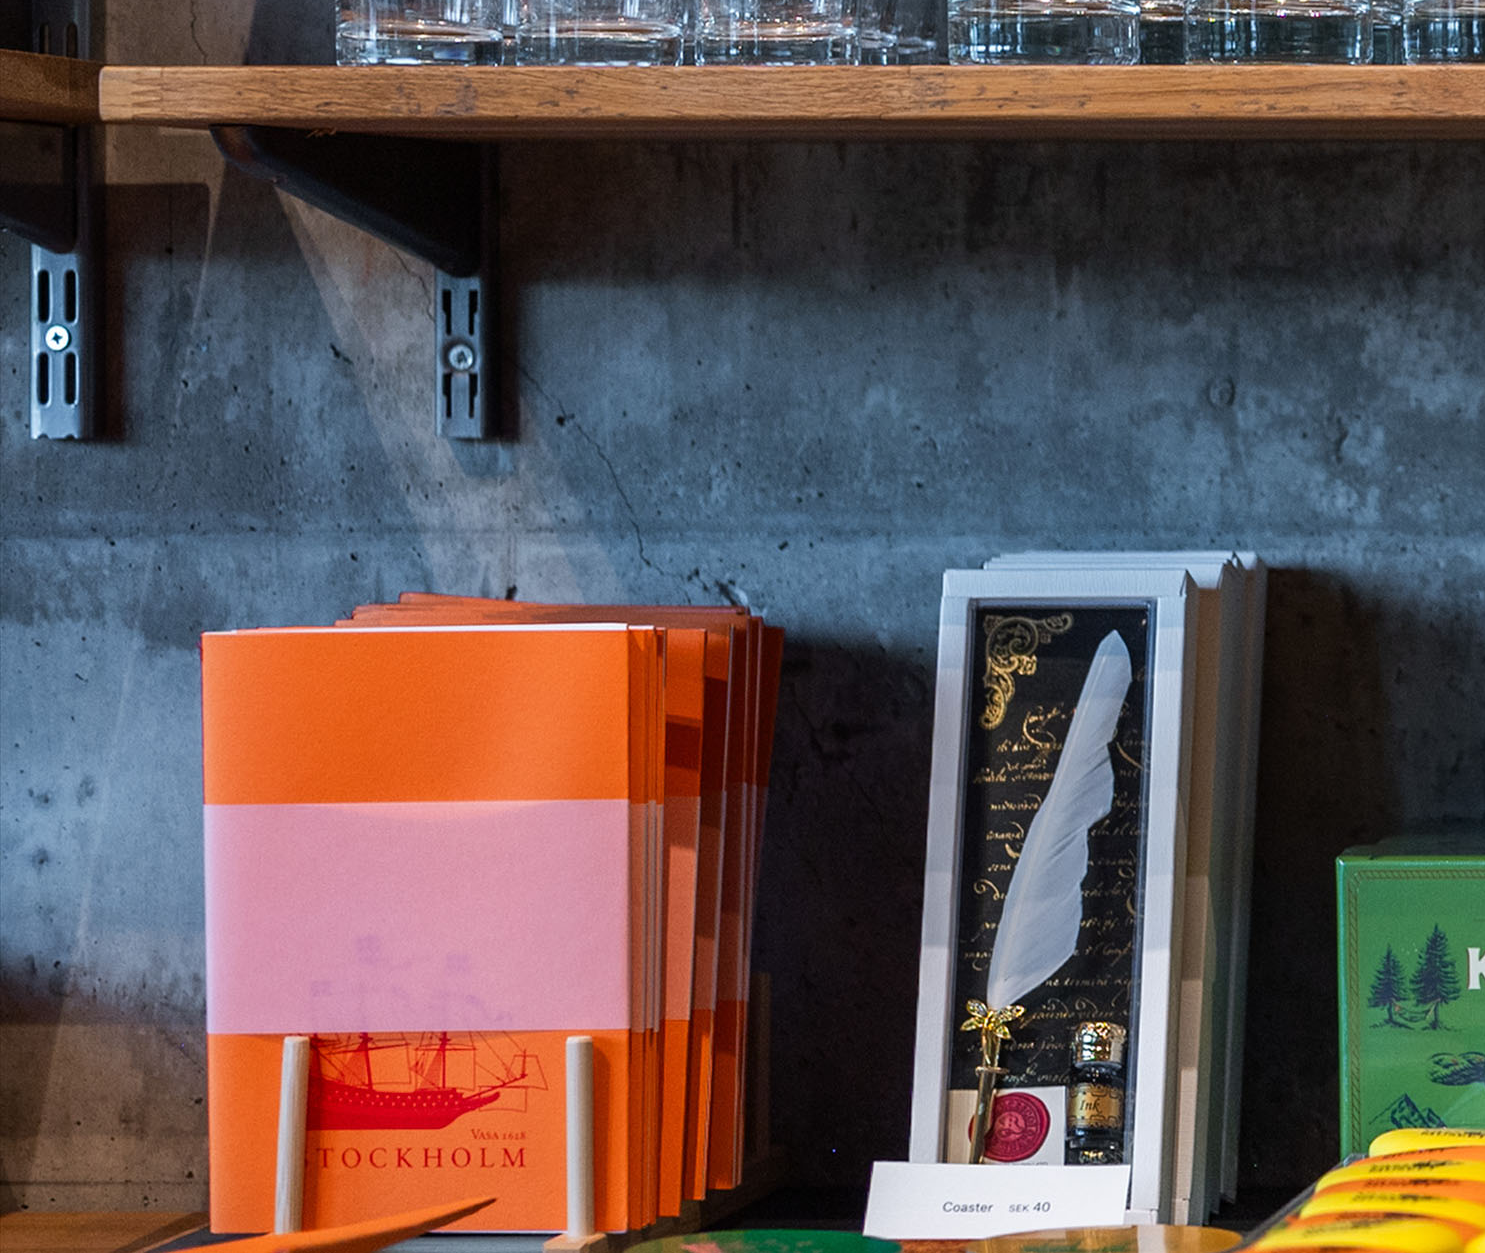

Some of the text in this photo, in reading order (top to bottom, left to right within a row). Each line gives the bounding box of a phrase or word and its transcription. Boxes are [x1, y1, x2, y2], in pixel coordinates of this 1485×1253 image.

[1079, 1099, 1102, 1113] Ink
[471, 1129, 526, 1140] VASA 1628
[305, 1147, 526, 1169] TOCKHOLM
[942, 1201, 1051, 1213] Coaster SEK 40
